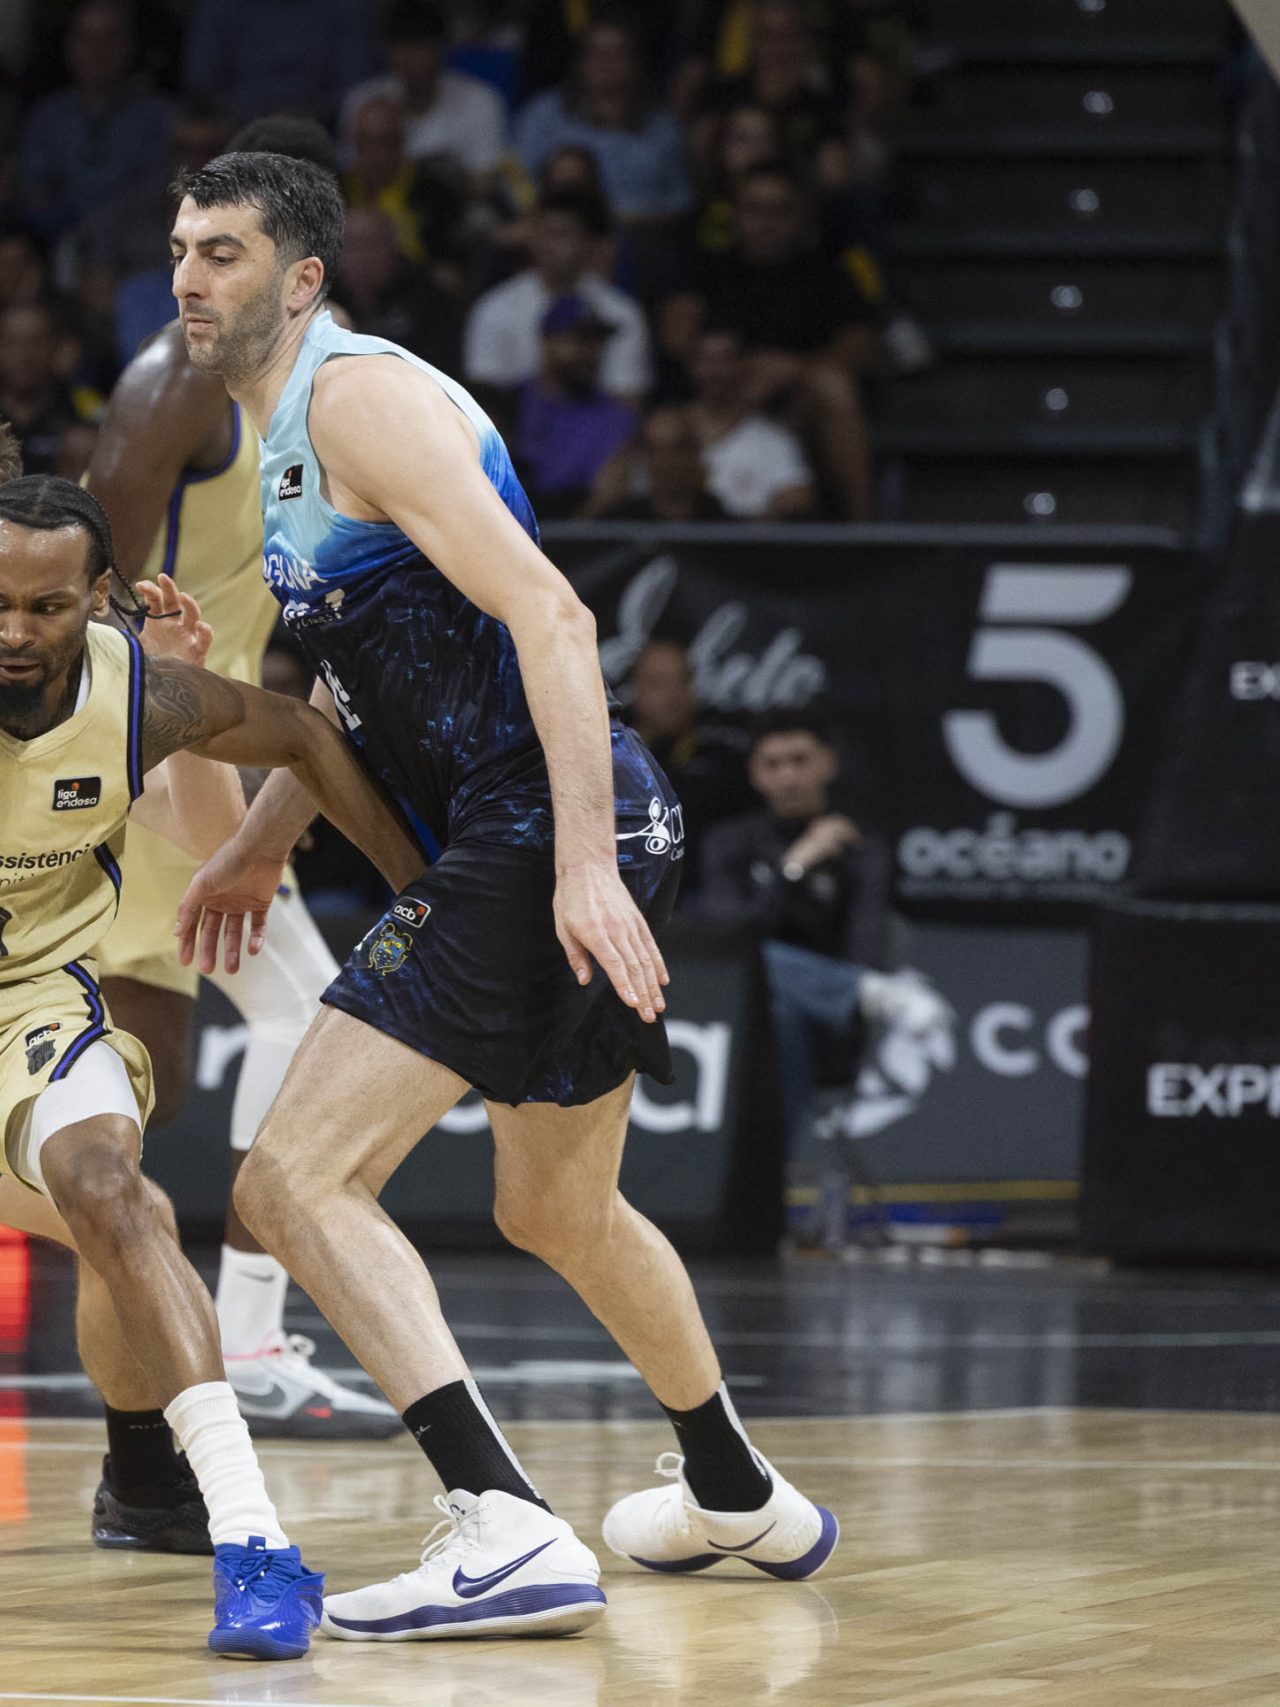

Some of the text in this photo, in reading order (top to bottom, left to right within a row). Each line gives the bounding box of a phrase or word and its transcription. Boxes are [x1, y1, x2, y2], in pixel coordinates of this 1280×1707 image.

[941, 562, 1133, 809] 5
[57, 788, 77, 800] liga
[56, 797, 97, 808] endesa
[898, 810, 1131, 883] océano
[393, 904, 417, 920] acb
